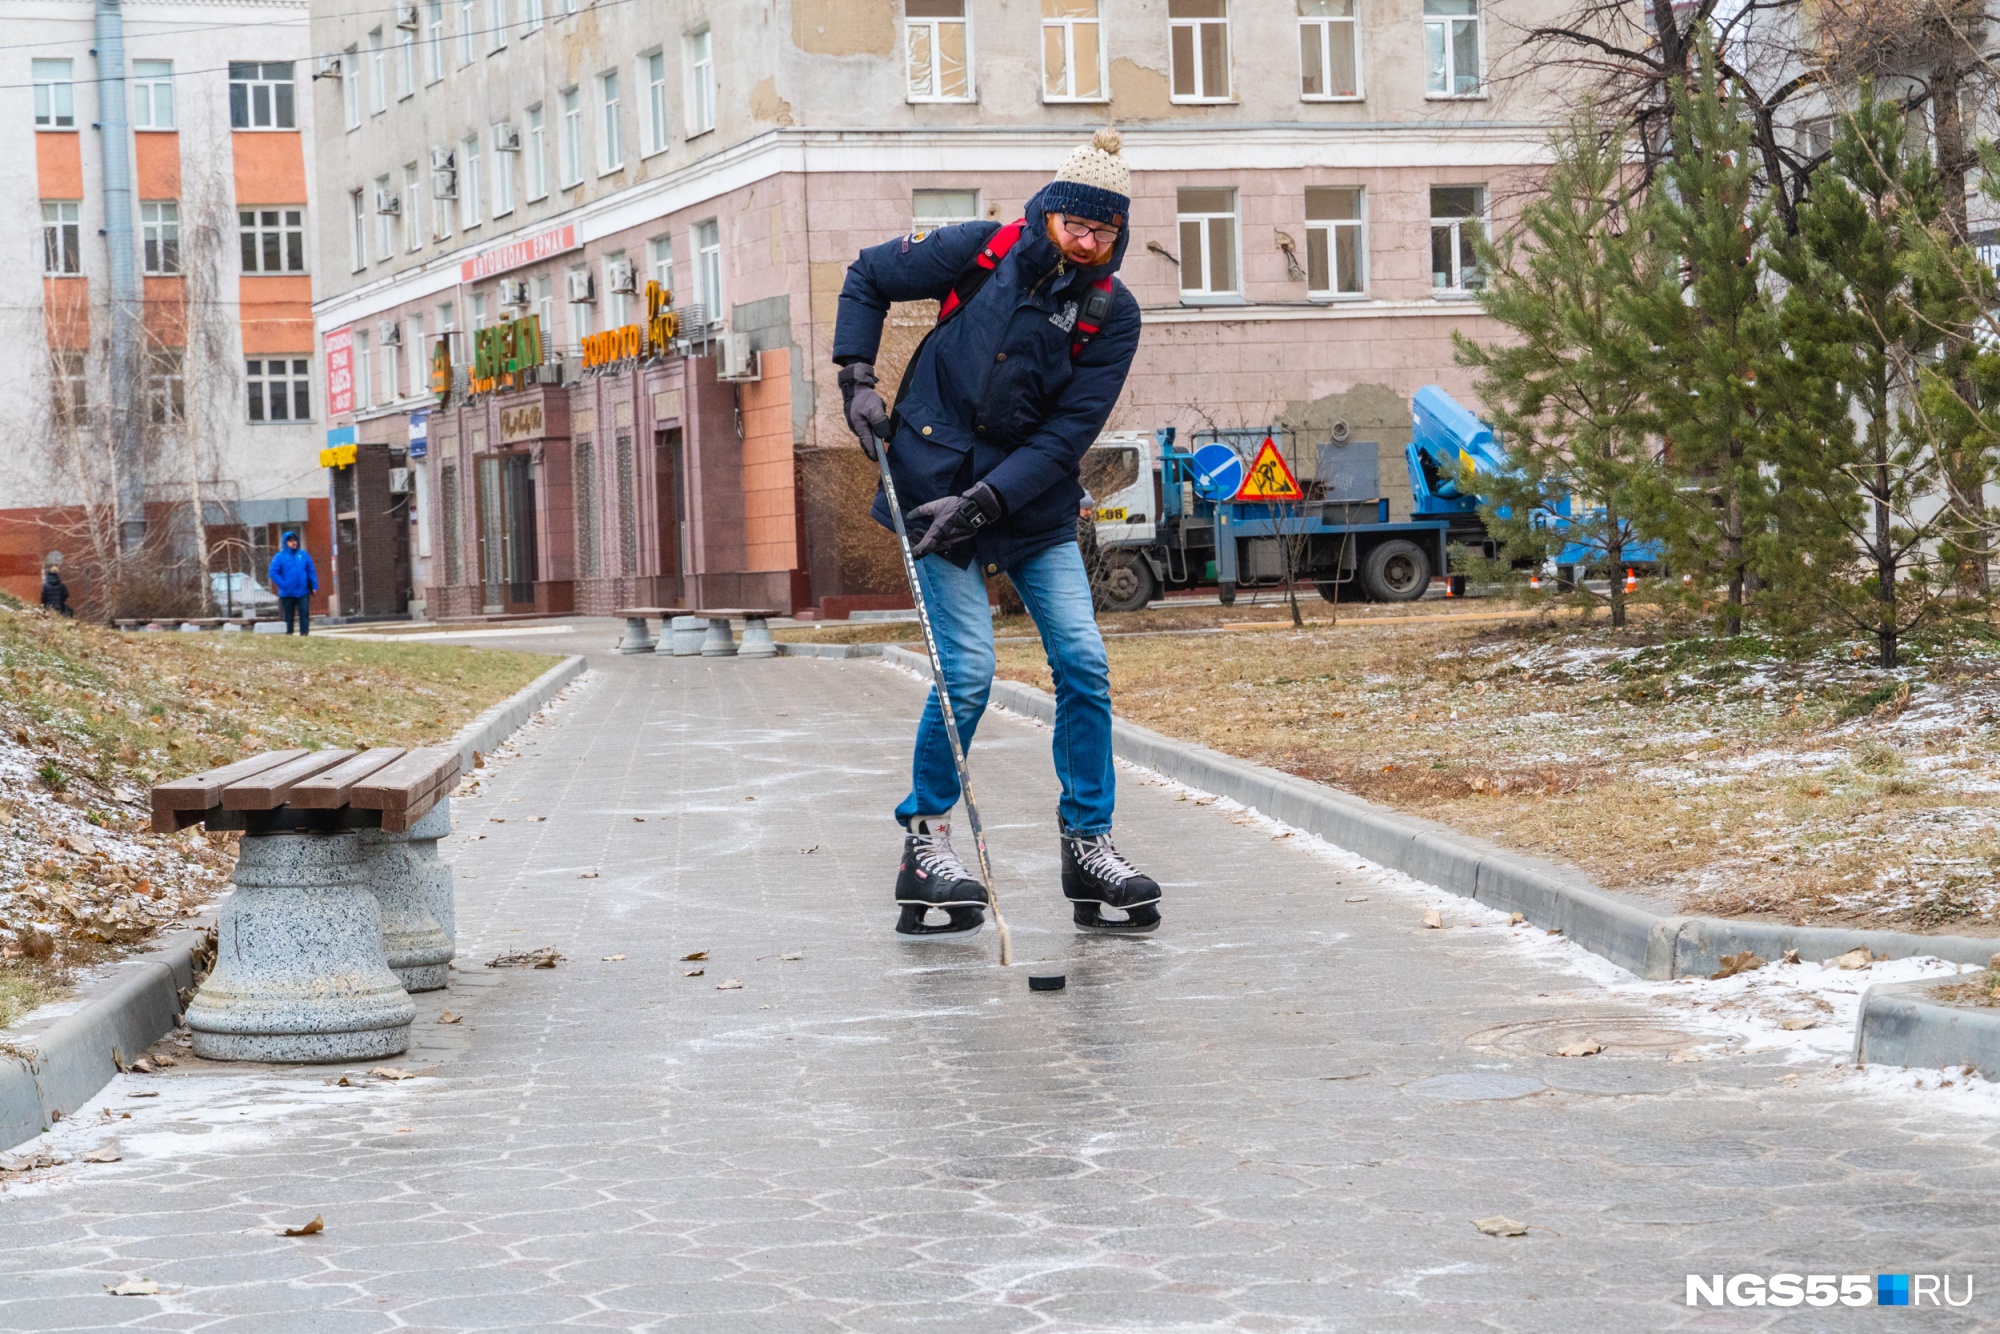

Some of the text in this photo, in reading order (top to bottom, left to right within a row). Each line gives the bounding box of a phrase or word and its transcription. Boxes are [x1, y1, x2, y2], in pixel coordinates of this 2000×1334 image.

[472, 228, 565, 279] АВТОШКОЛА ЕРМАК
[581, 323, 641, 368] ЗОЛОТО
[901, 535, 942, 672] SHER-WOOD
